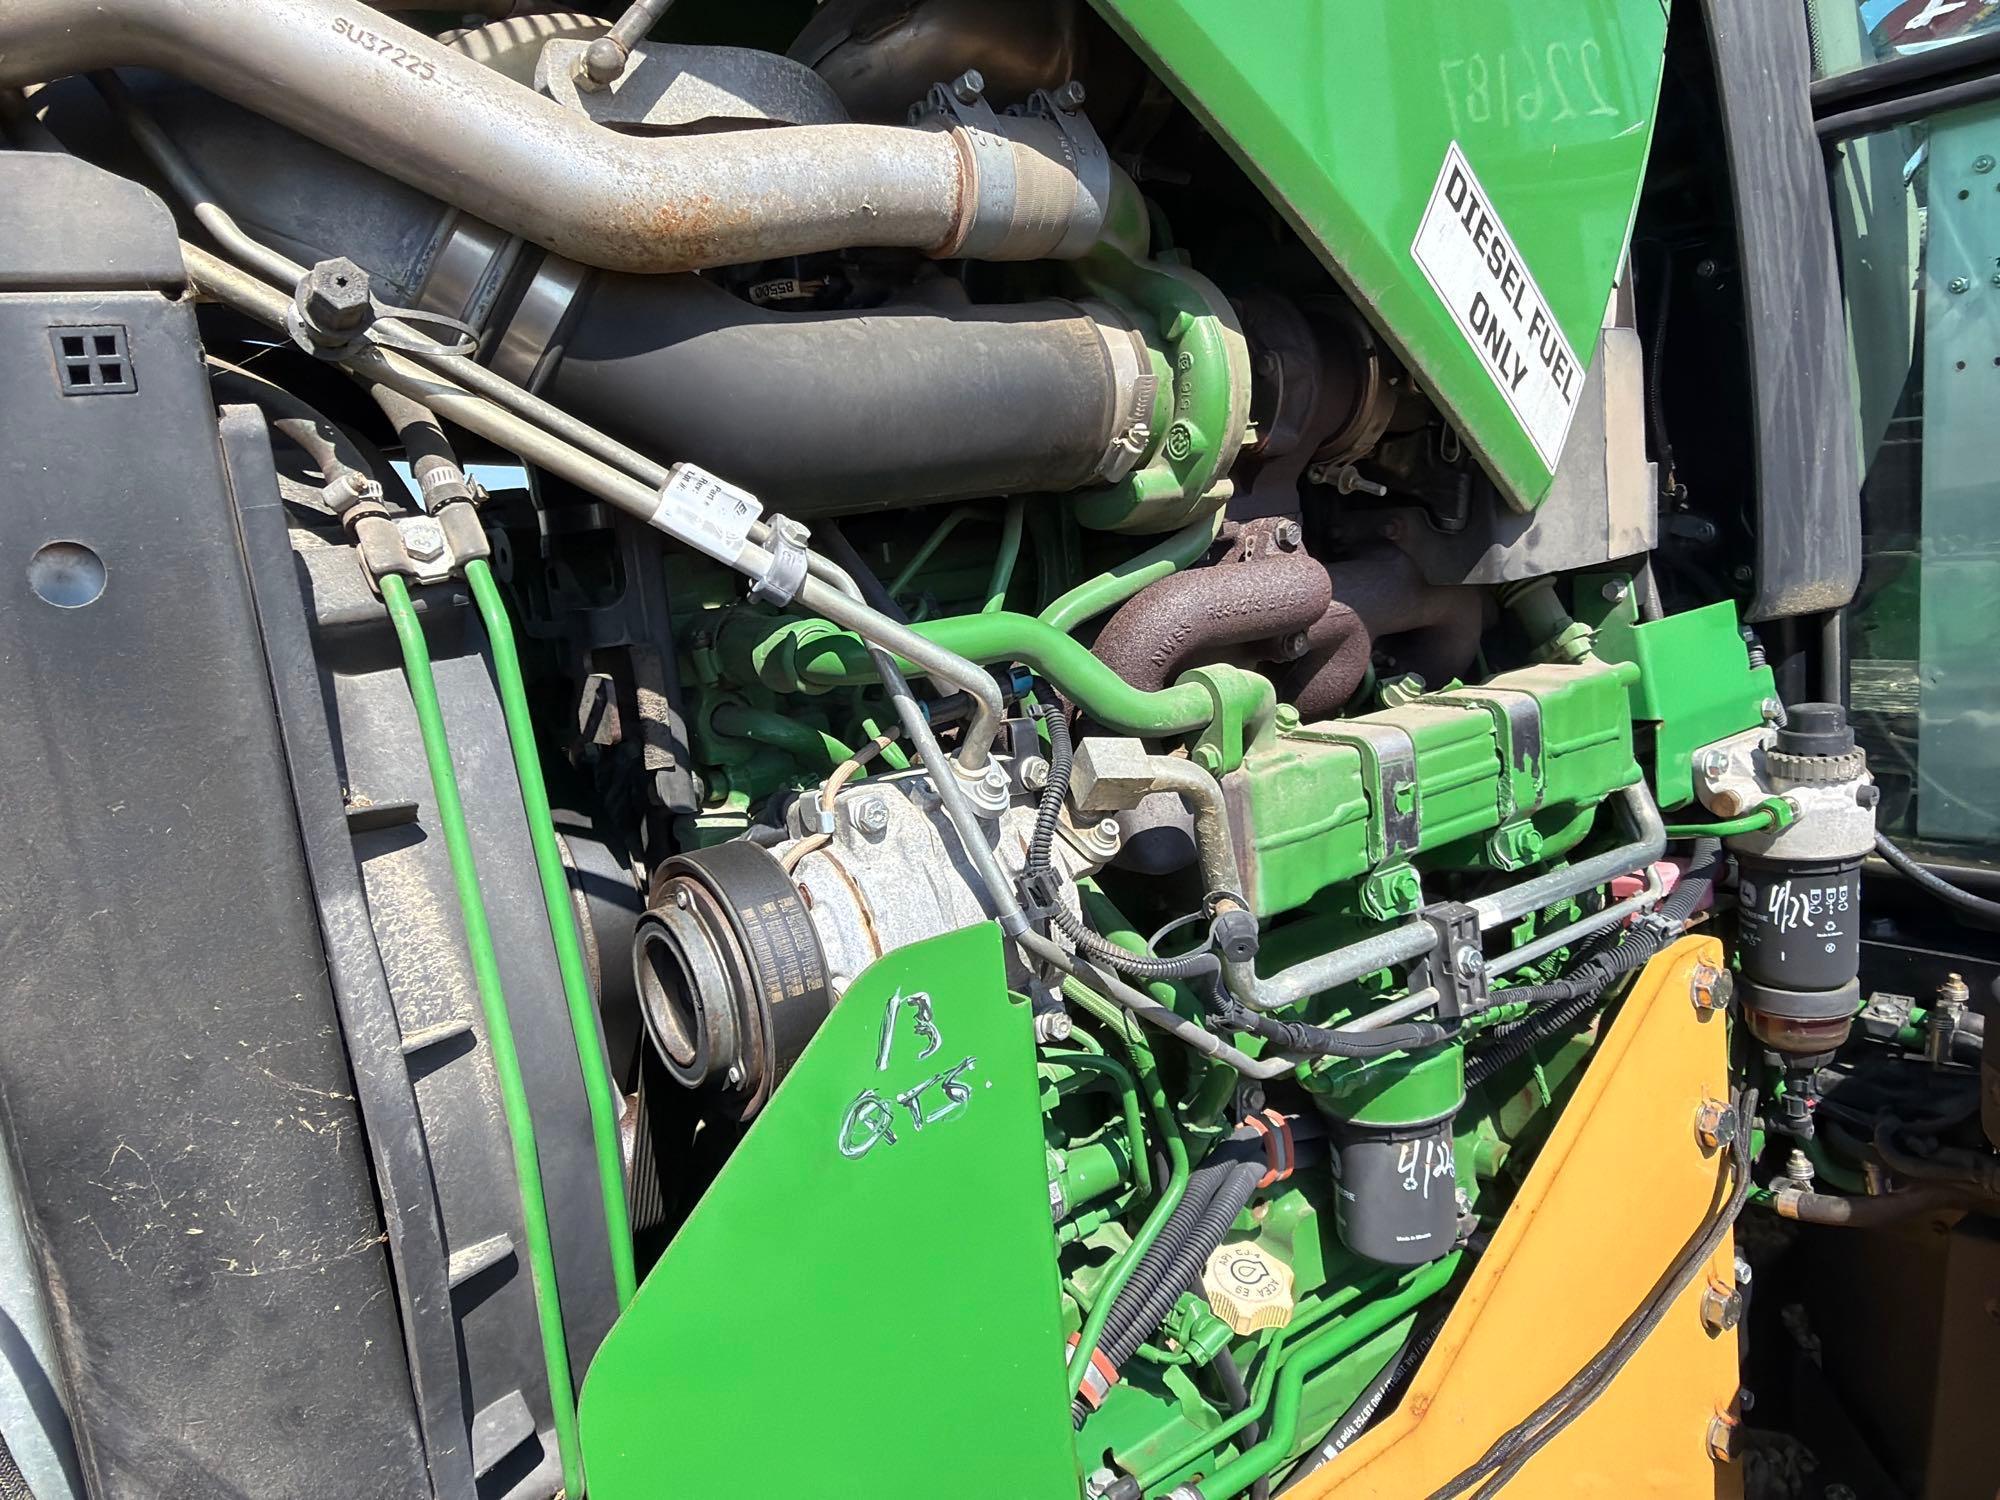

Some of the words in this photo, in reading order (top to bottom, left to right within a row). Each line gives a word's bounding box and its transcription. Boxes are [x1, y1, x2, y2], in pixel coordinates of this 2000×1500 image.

[332, 17, 436, 81] SU37225
[1444, 164, 1527, 322] DIESEL
[1527, 306, 1574, 406] FUEL
[1469, 291, 1528, 393] ONLY
[1219, 1253, 1233, 1266] API
[1235, 1285, 1250, 1297] E9
[1257, 1278, 1280, 1298] ACEA
[1340, 1424, 1357, 1443] Type
